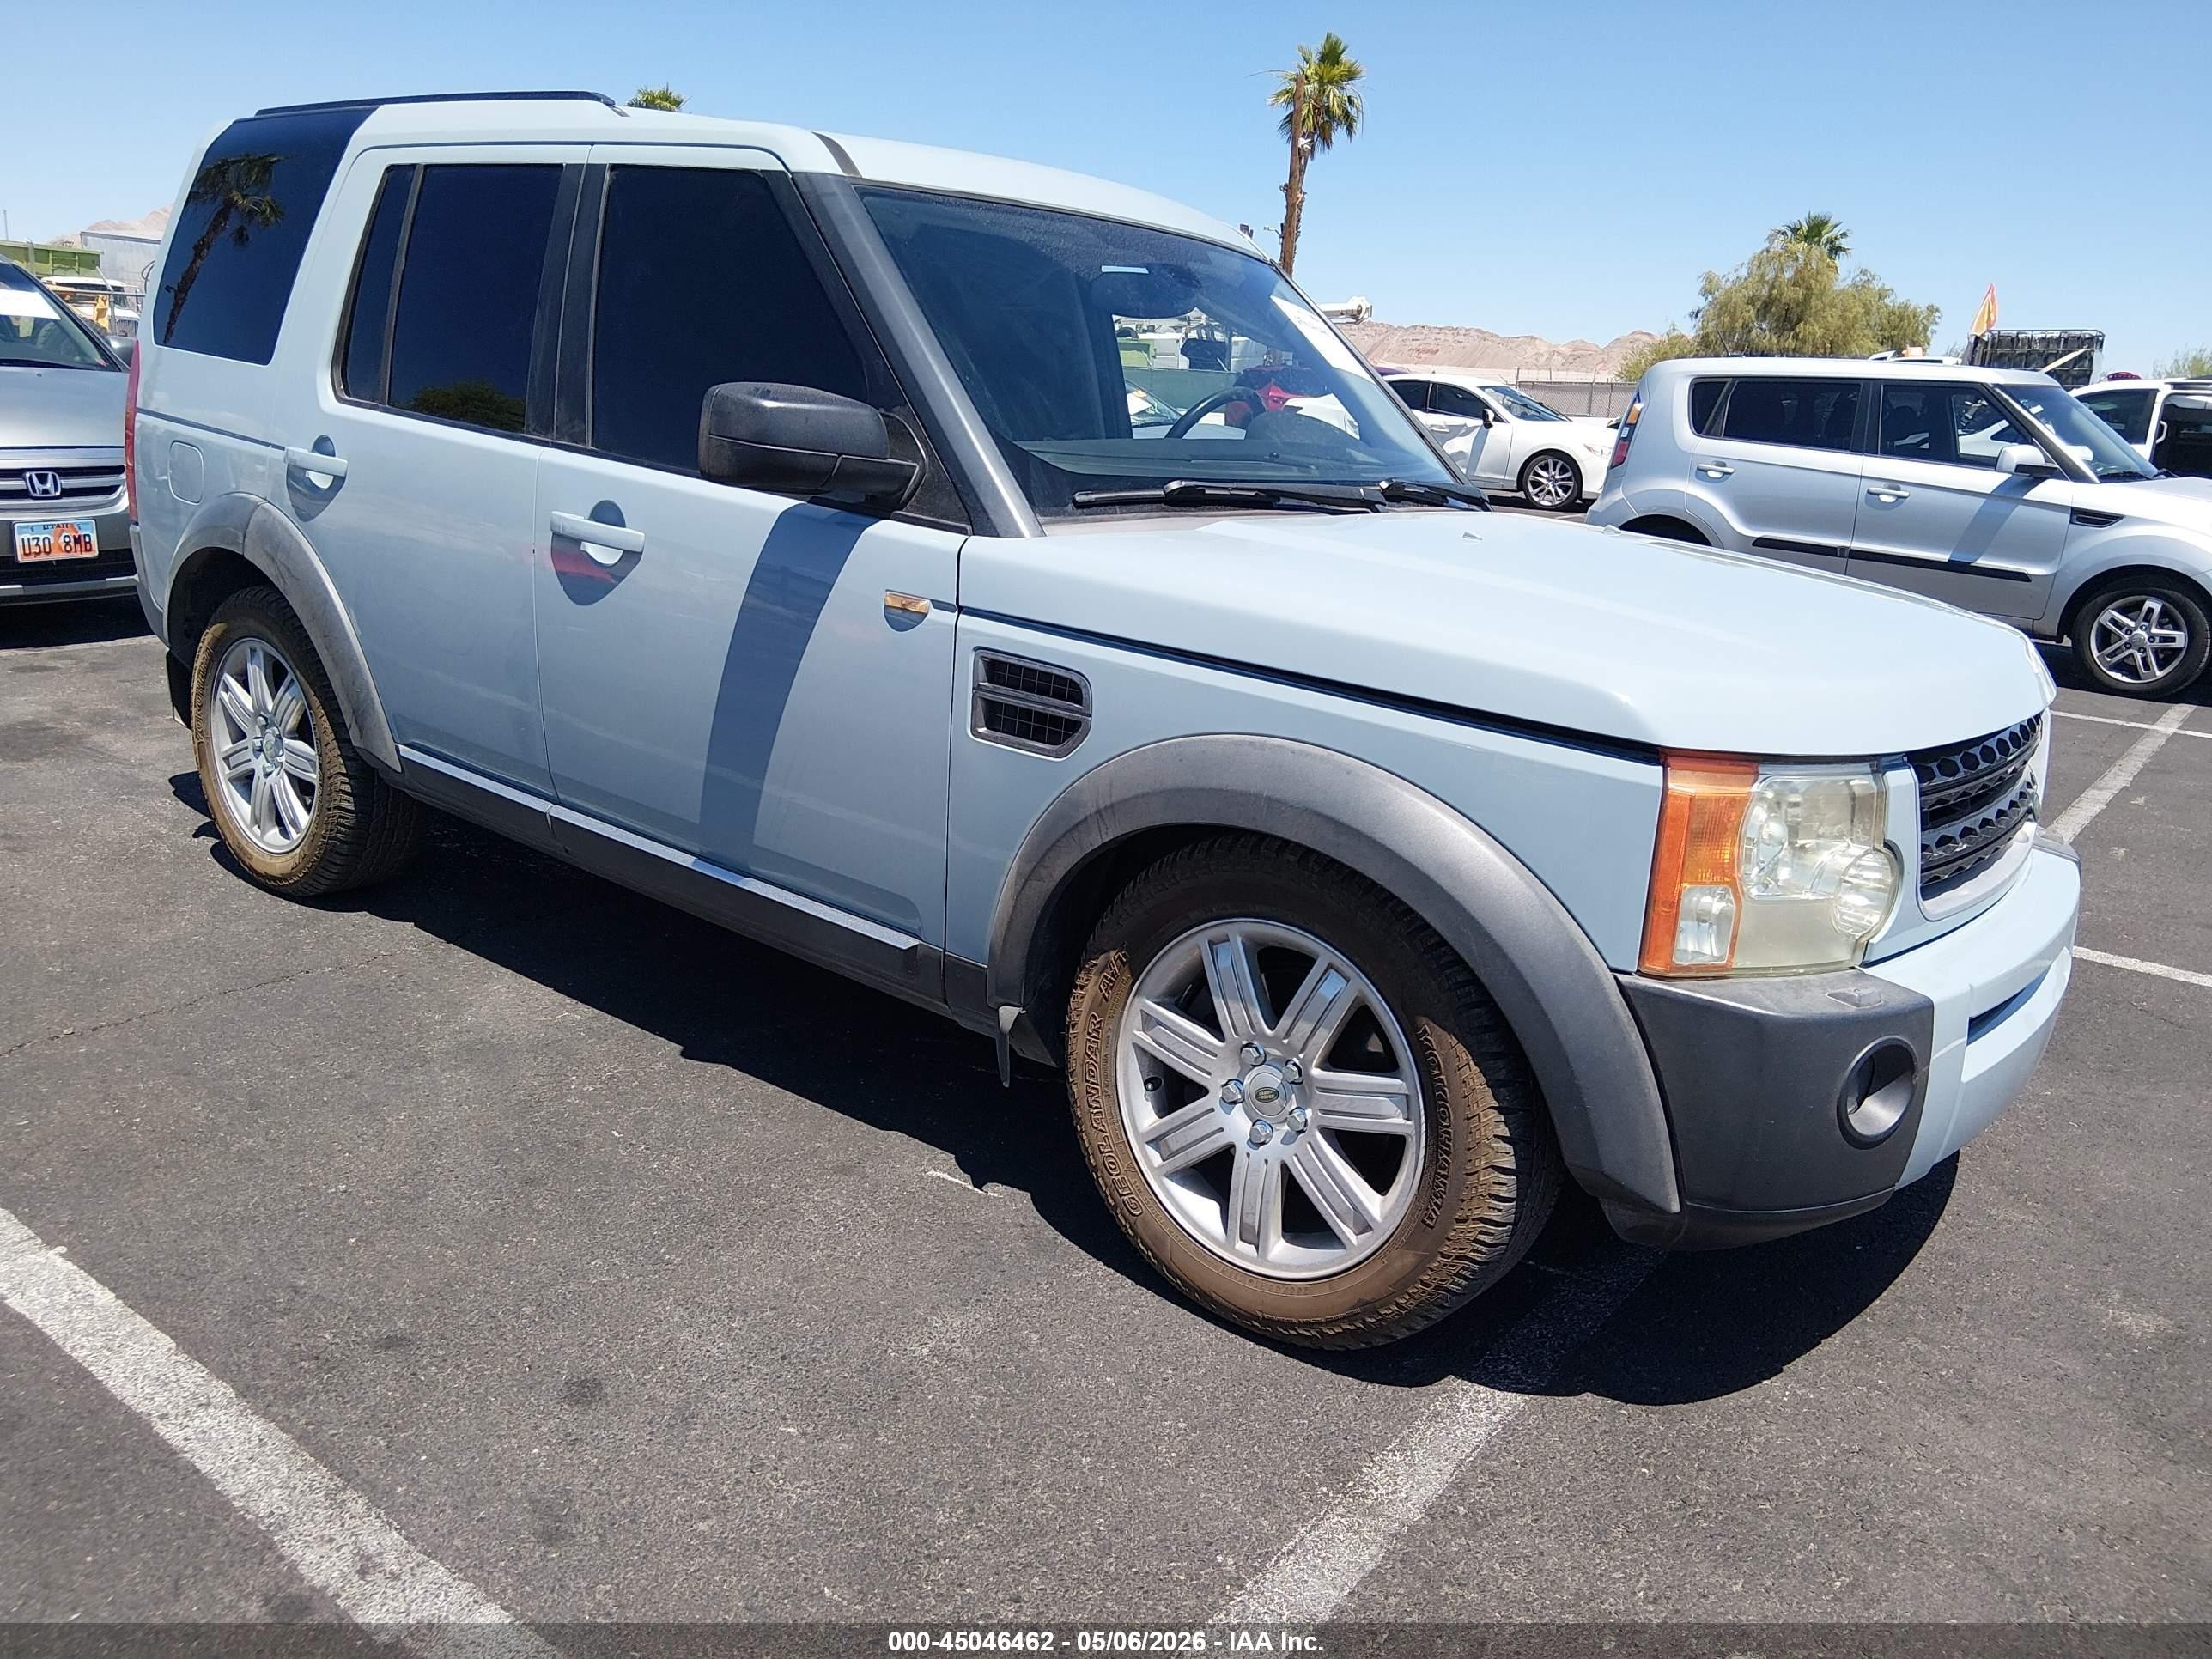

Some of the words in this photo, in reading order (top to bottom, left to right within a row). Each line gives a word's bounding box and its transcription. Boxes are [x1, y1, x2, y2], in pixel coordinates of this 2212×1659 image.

[63, 533, 93, 555] 8MB
[1083, 1012, 1144, 1217] GEOLANDAR
[1418, 1024, 1454, 1230] YOKOHAMA
